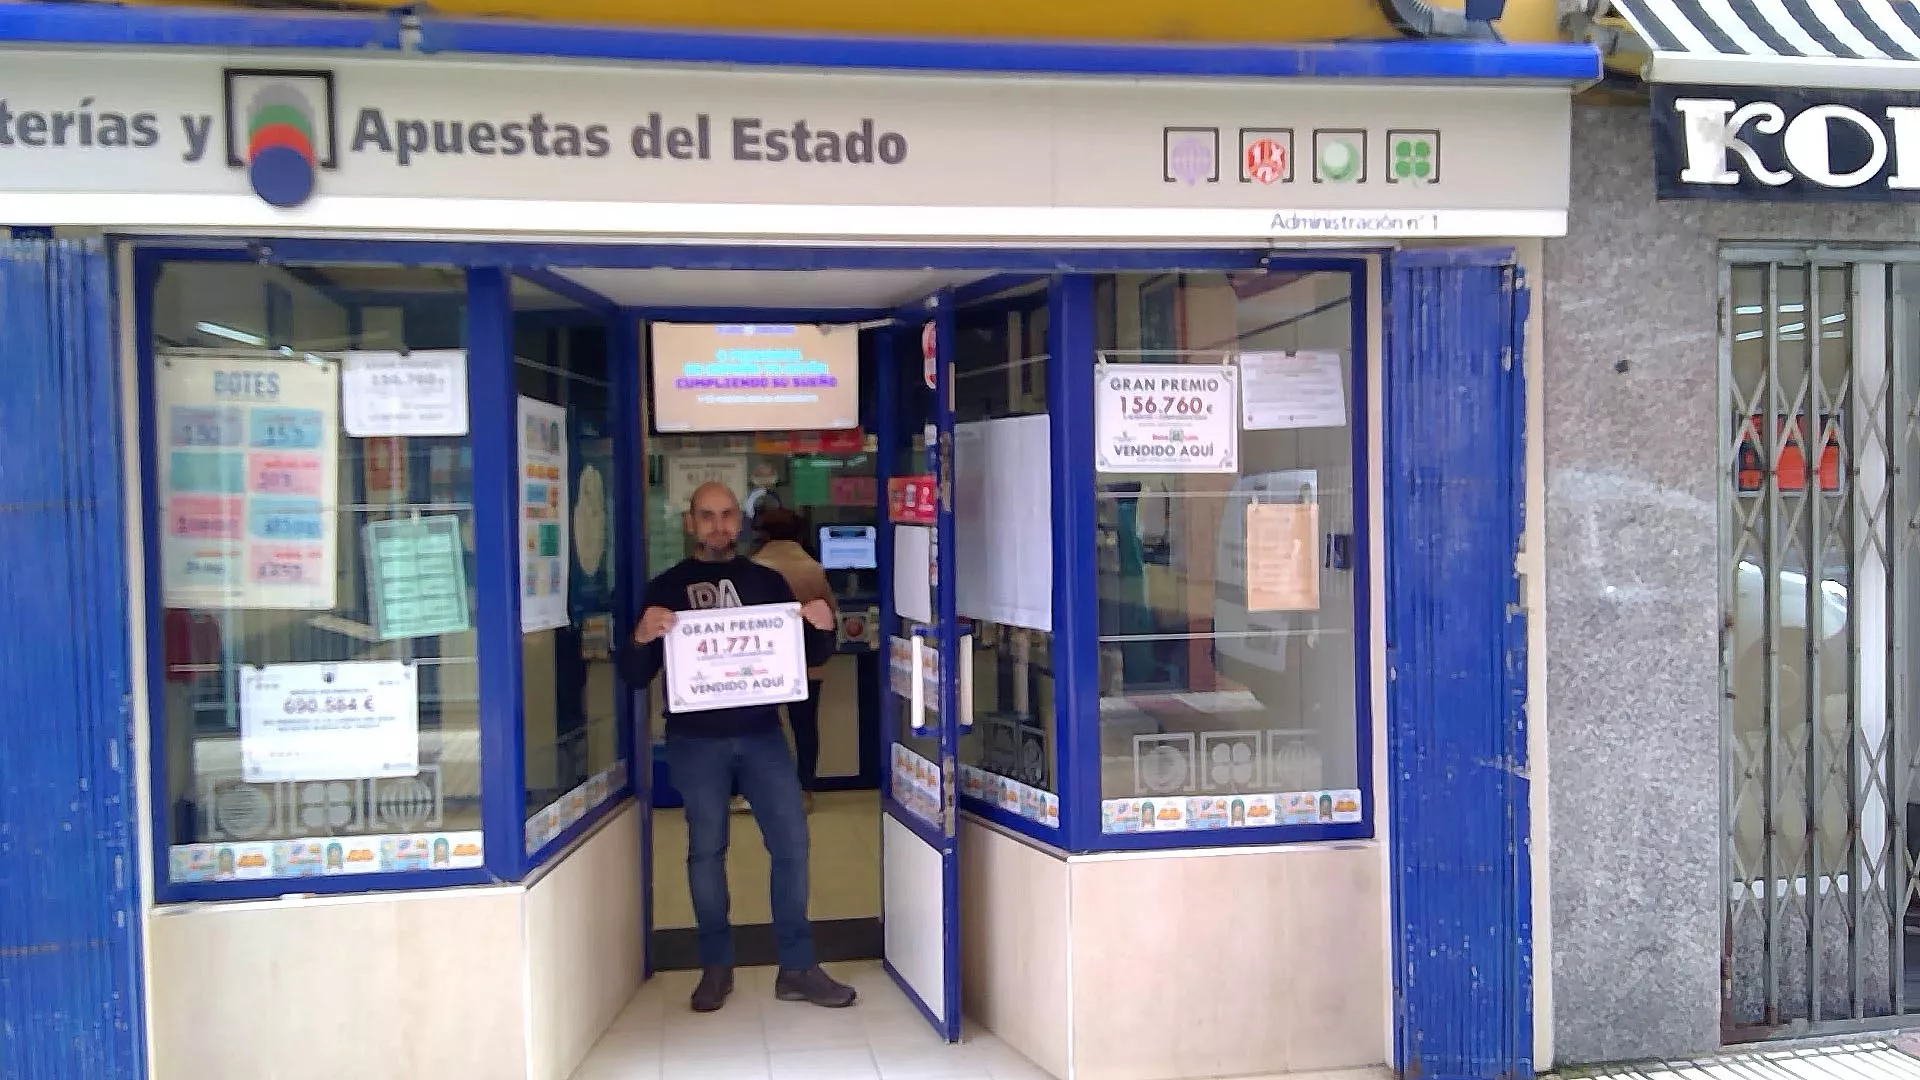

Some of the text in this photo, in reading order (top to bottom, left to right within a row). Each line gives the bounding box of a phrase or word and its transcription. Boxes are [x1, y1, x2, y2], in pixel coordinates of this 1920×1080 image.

[182, 114, 213, 161] y
[351, 107, 611, 167] Apuestas
[631, 112, 712, 161] del
[732, 115, 909, 166] Estado
[1270, 212, 1404, 231] Administración
[1432, 214, 1440, 231] 1
[212, 370, 281, 397] BOTES
[1109, 378, 1220, 393] GRAN PREMIO
[1119, 395, 1203, 416] 156.760
[1113, 442, 1214, 458] VENDIDO AQUÍ
[682, 616, 784, 637] GRAN PREMIO
[696, 635, 761, 655] 41.771
[690, 674, 785, 695] VENDIDO AQUÍ
